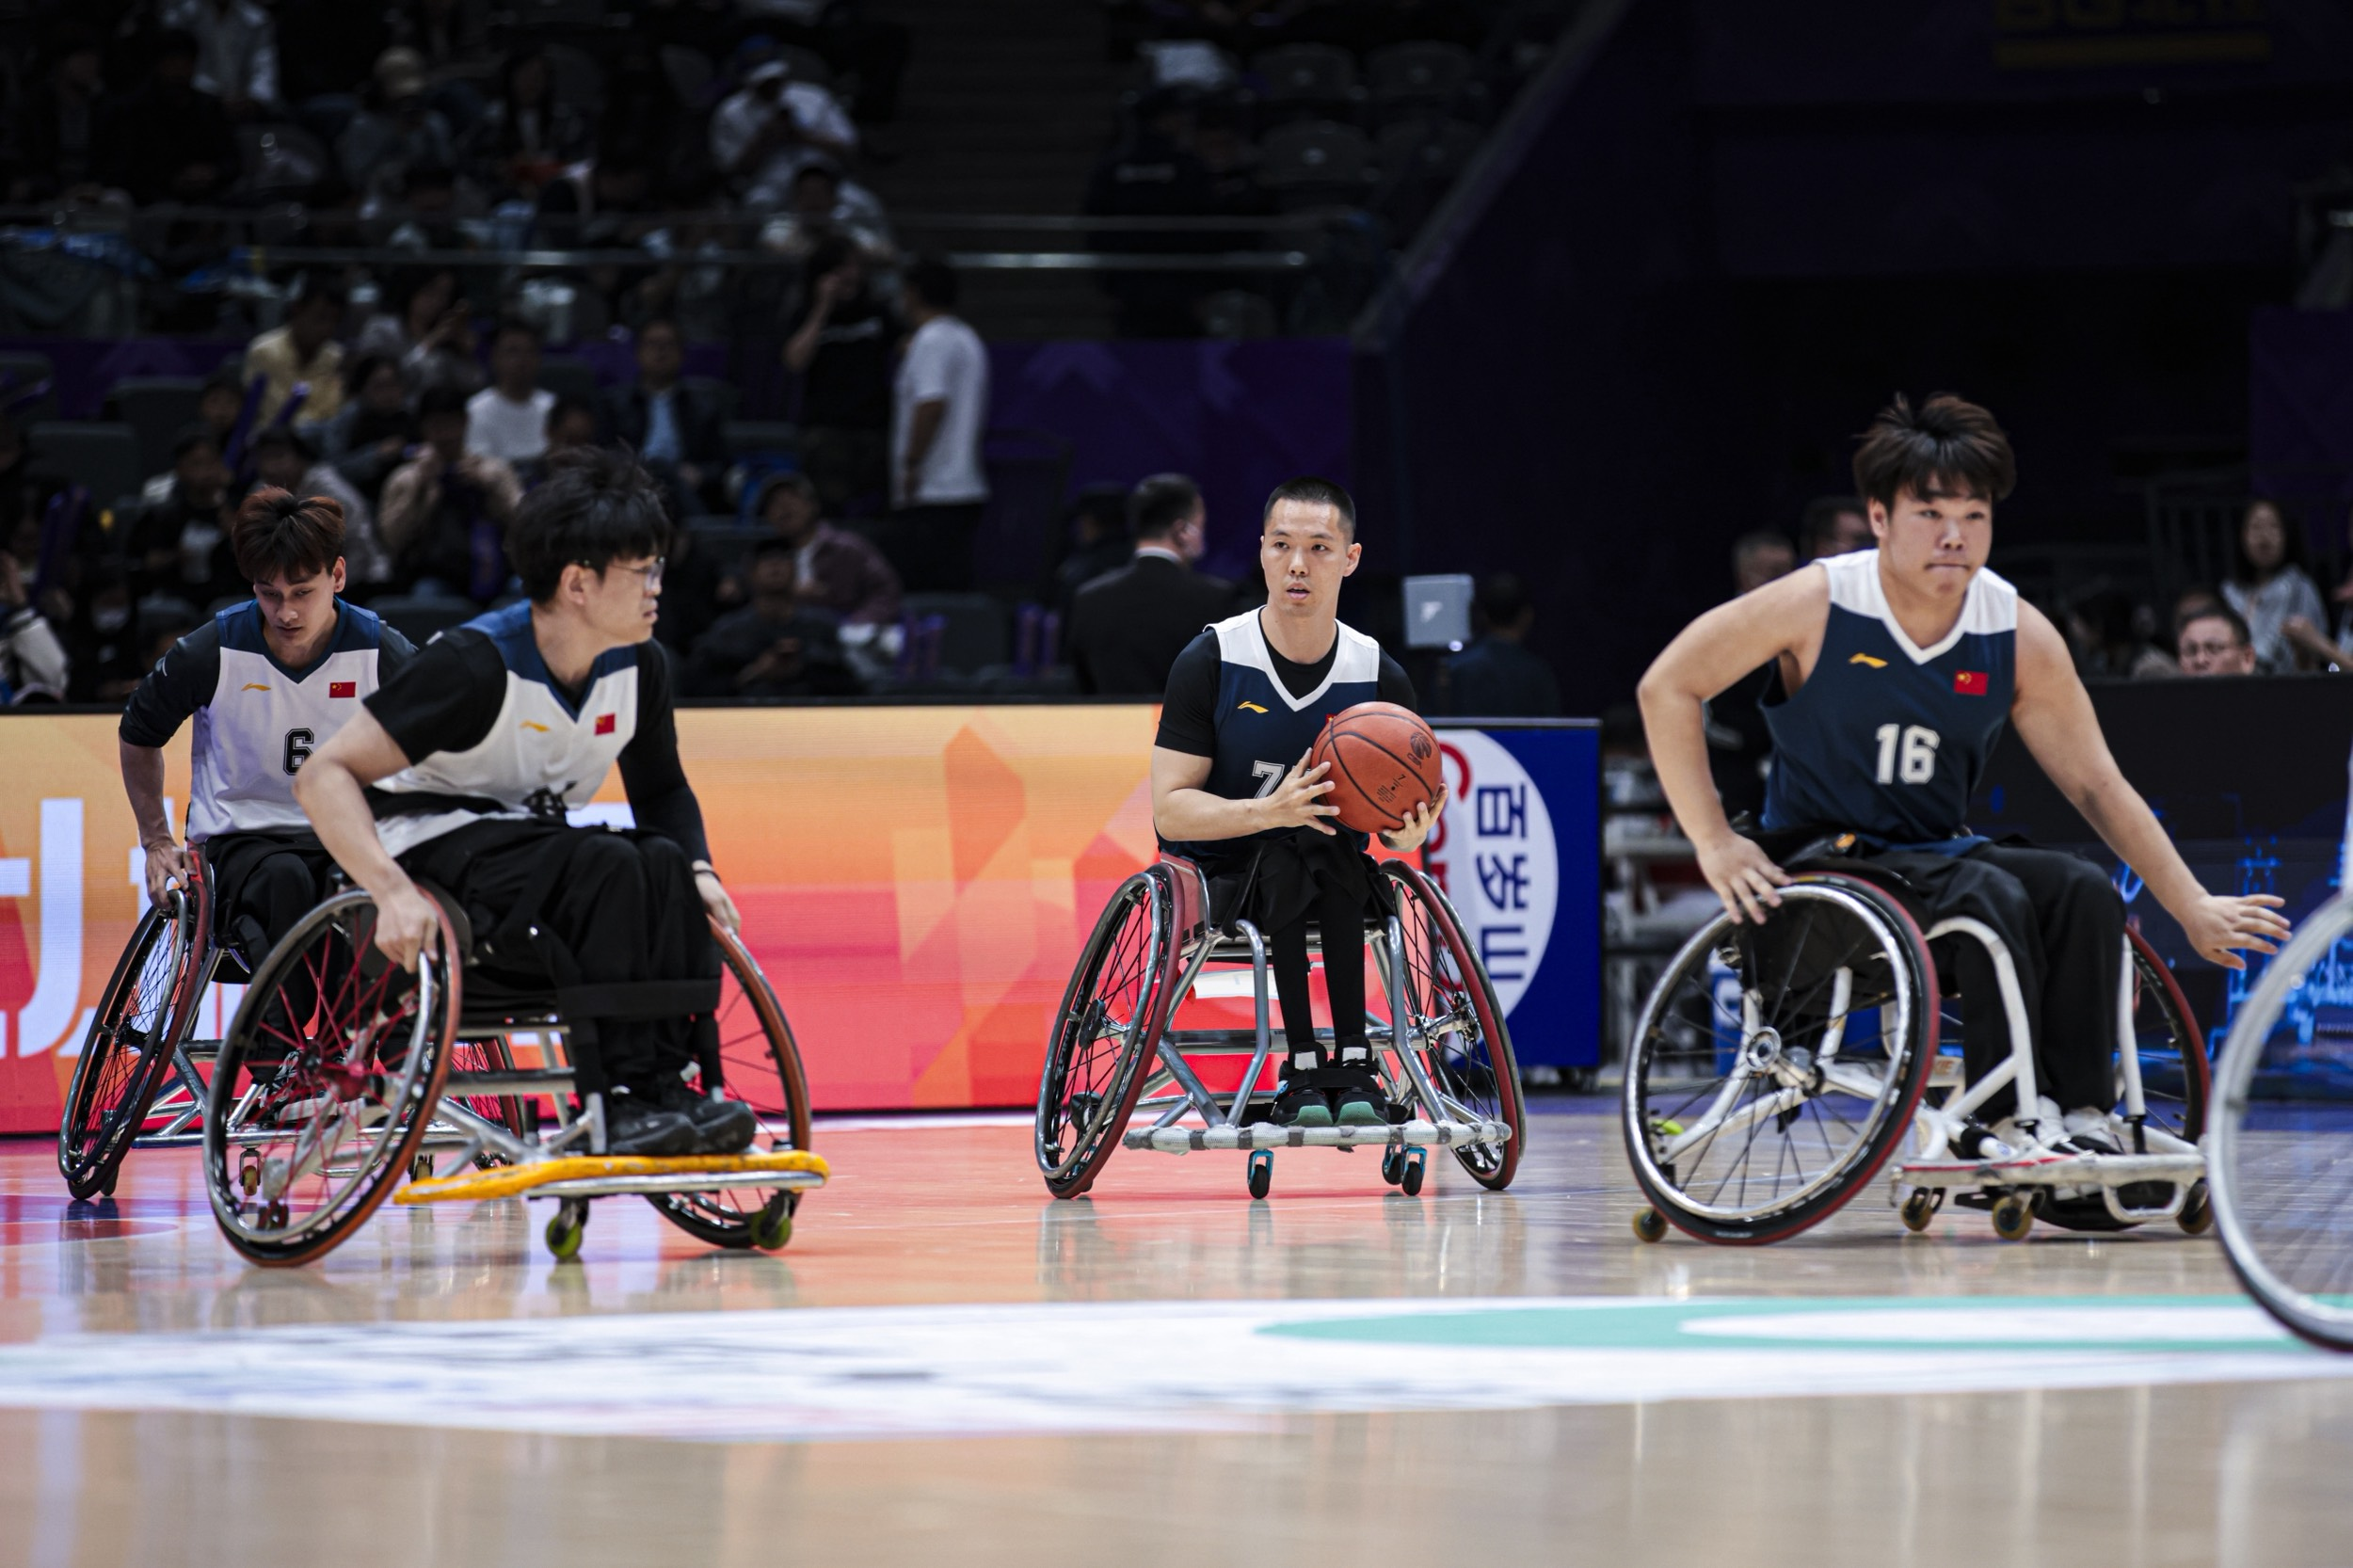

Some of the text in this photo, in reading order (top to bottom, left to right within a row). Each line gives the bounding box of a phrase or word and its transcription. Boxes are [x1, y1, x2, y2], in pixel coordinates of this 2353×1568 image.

[283, 728, 313, 776] 6
[1876, 724, 1940, 785] 16
[1477, 782, 1529, 980] 百岁山
